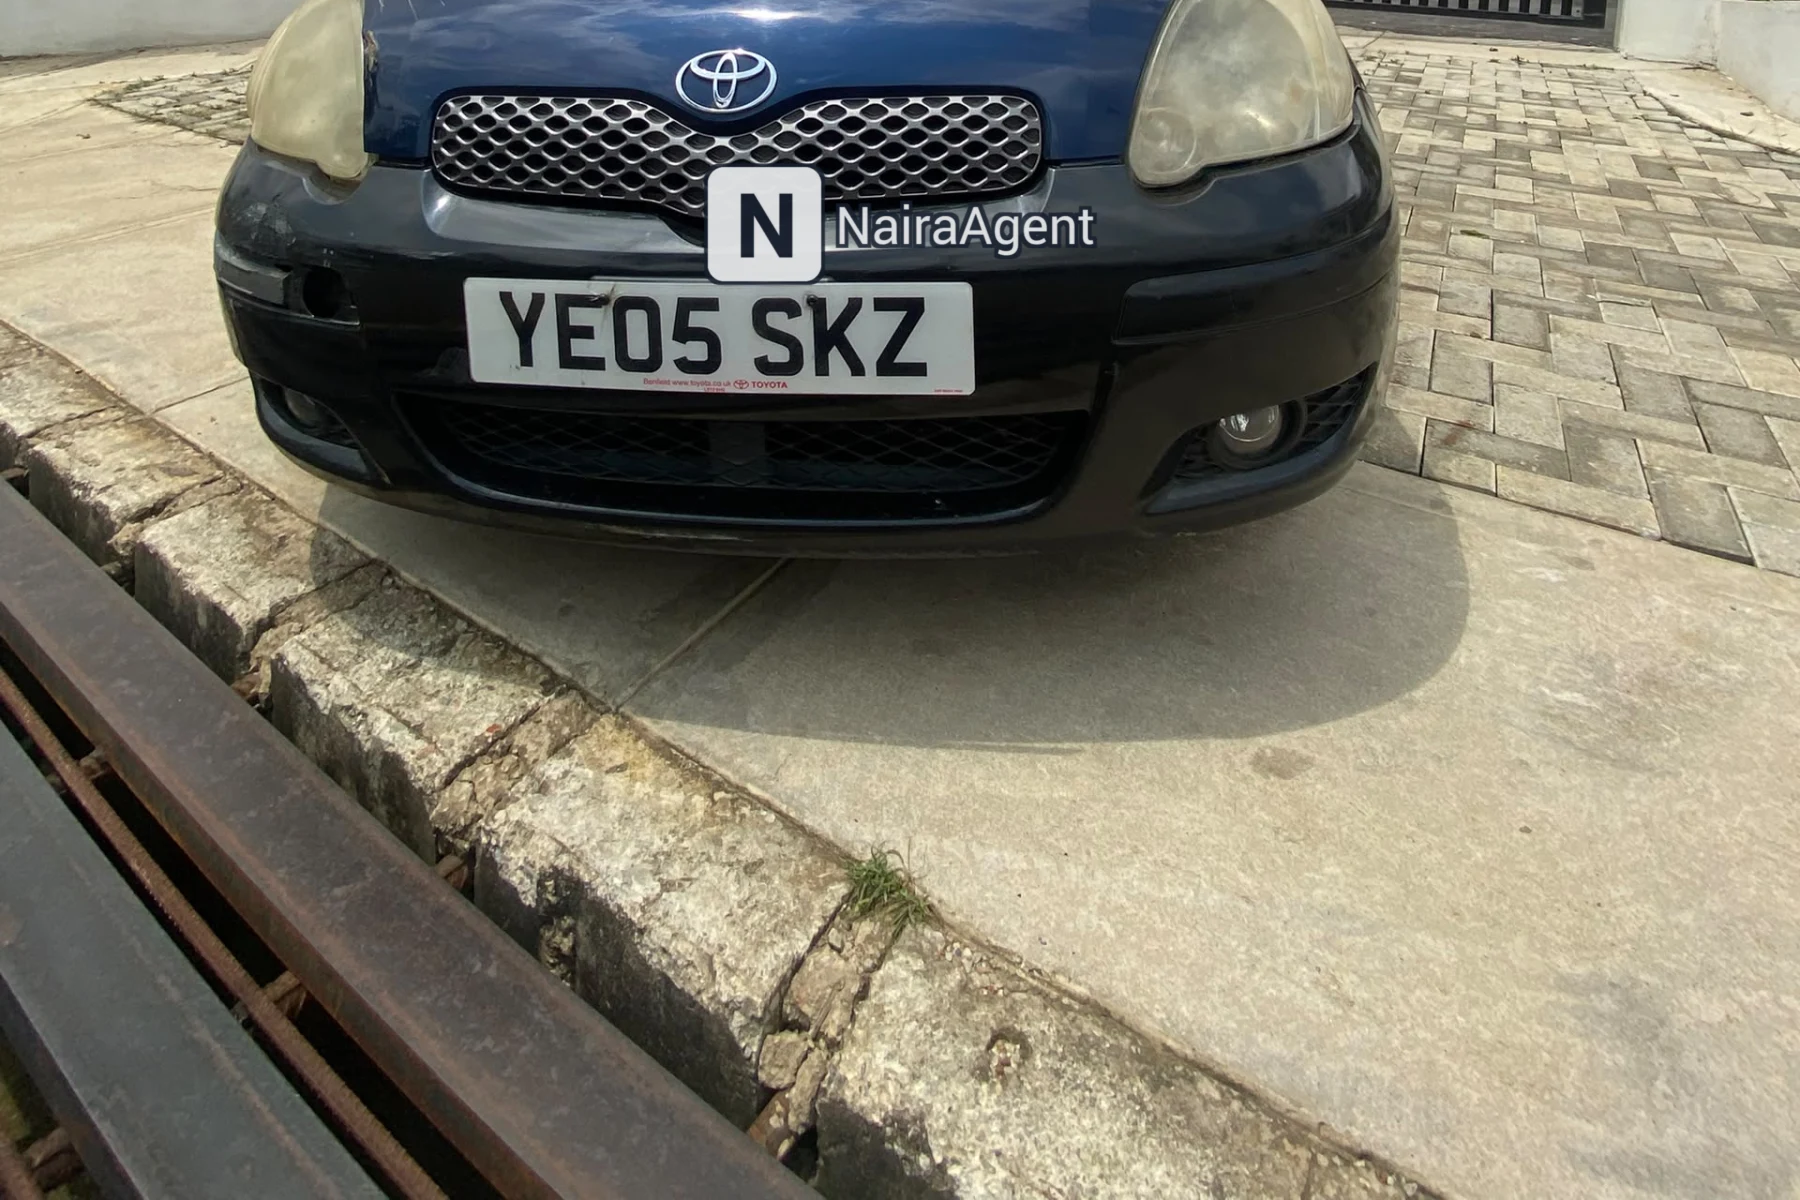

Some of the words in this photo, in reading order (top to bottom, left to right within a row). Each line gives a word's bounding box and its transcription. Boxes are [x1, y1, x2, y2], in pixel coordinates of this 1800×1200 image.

[500, 291, 722, 375] YE05
[752, 296, 928, 378] SKZ
[751, 381, 788, 389] TOYOTA
